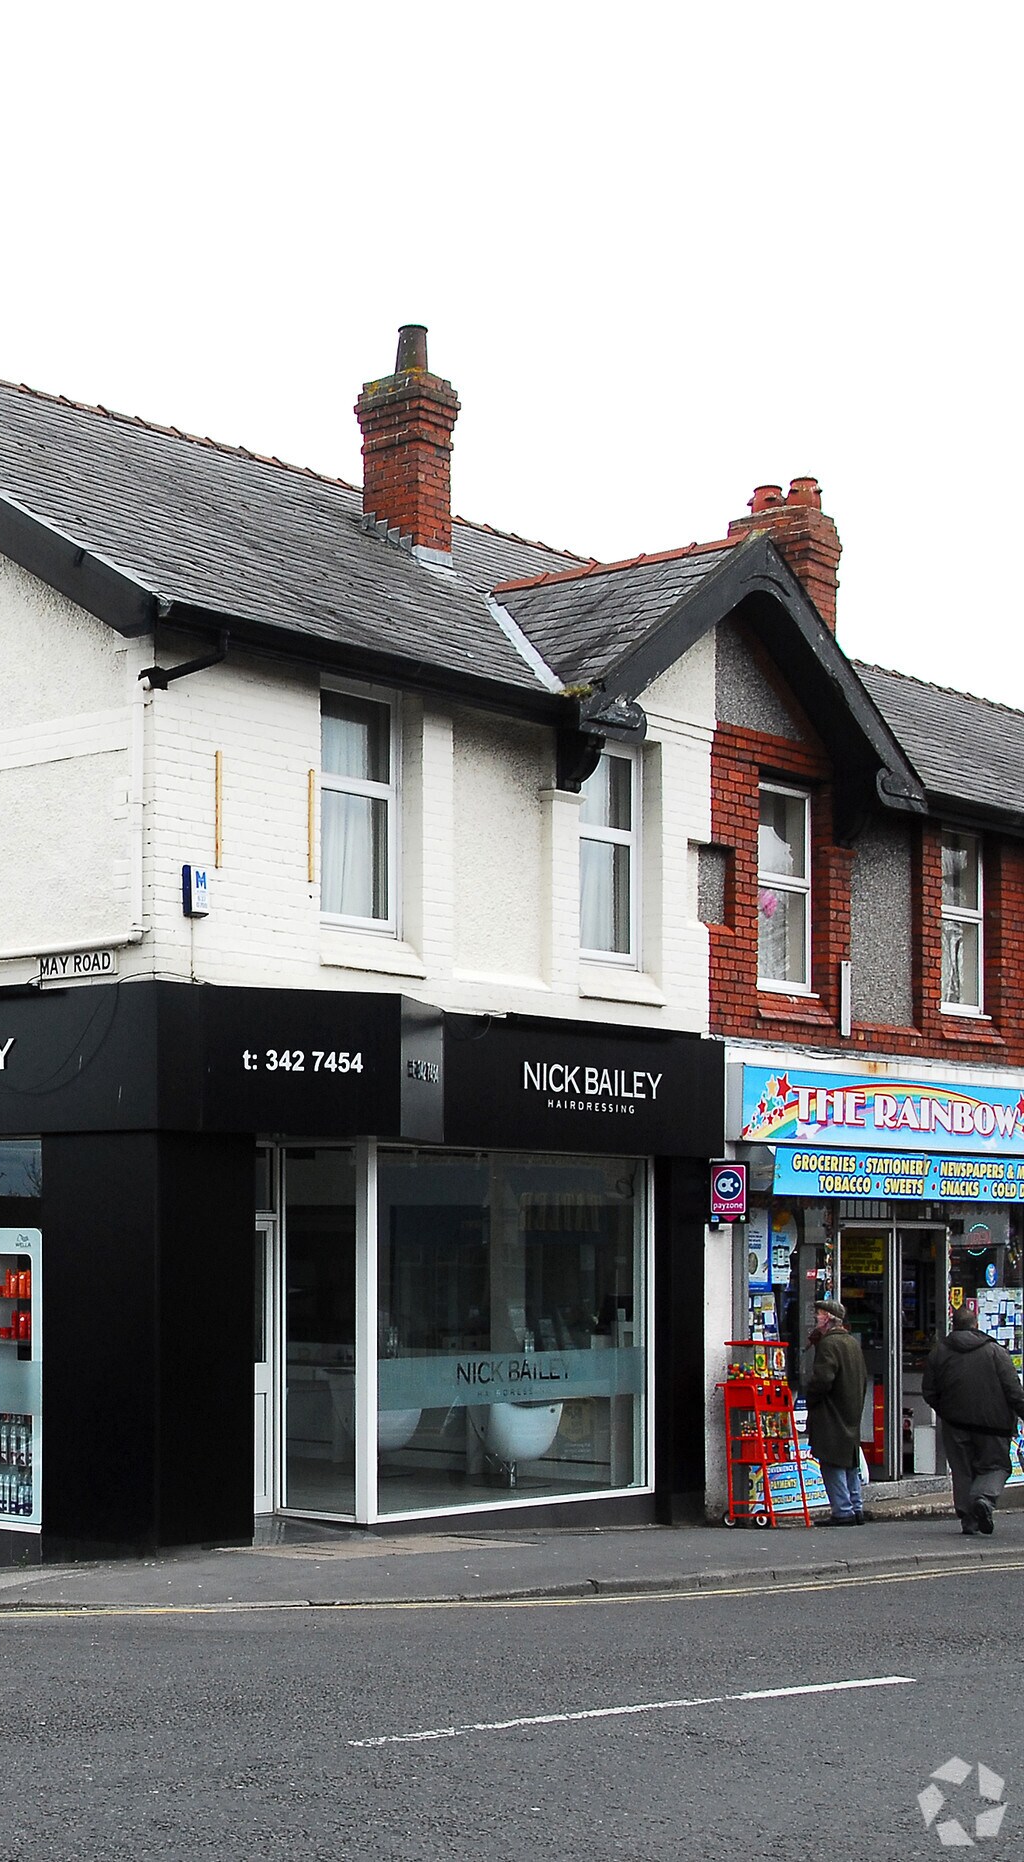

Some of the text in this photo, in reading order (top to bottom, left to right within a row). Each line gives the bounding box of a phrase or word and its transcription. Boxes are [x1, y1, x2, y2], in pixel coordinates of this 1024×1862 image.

[40, 952, 111, 975] MAY ROAD
[242, 1049, 364, 1073] t: 342 7454
[523, 1061, 663, 1099] NICK BAILEY
[547, 1099, 635, 1114] HAIRDRESSING
[792, 1085, 1019, 1139] THE RAINBOW
[792, 1152, 856, 1173] GROCERIES
[865, 1157, 932, 1177] STATIONERY
[939, 1161, 1004, 1180] NEWSPAPERS
[818, 1175, 872, 1194] TOBACCO
[883, 1178, 924, 1196] SWEETS
[939, 1180, 979, 1197] SNACKS
[990, 1181, 1017, 1199] COLD
[713, 1202, 744, 1211] payzone
[456, 1360, 504, 1385] NICK
